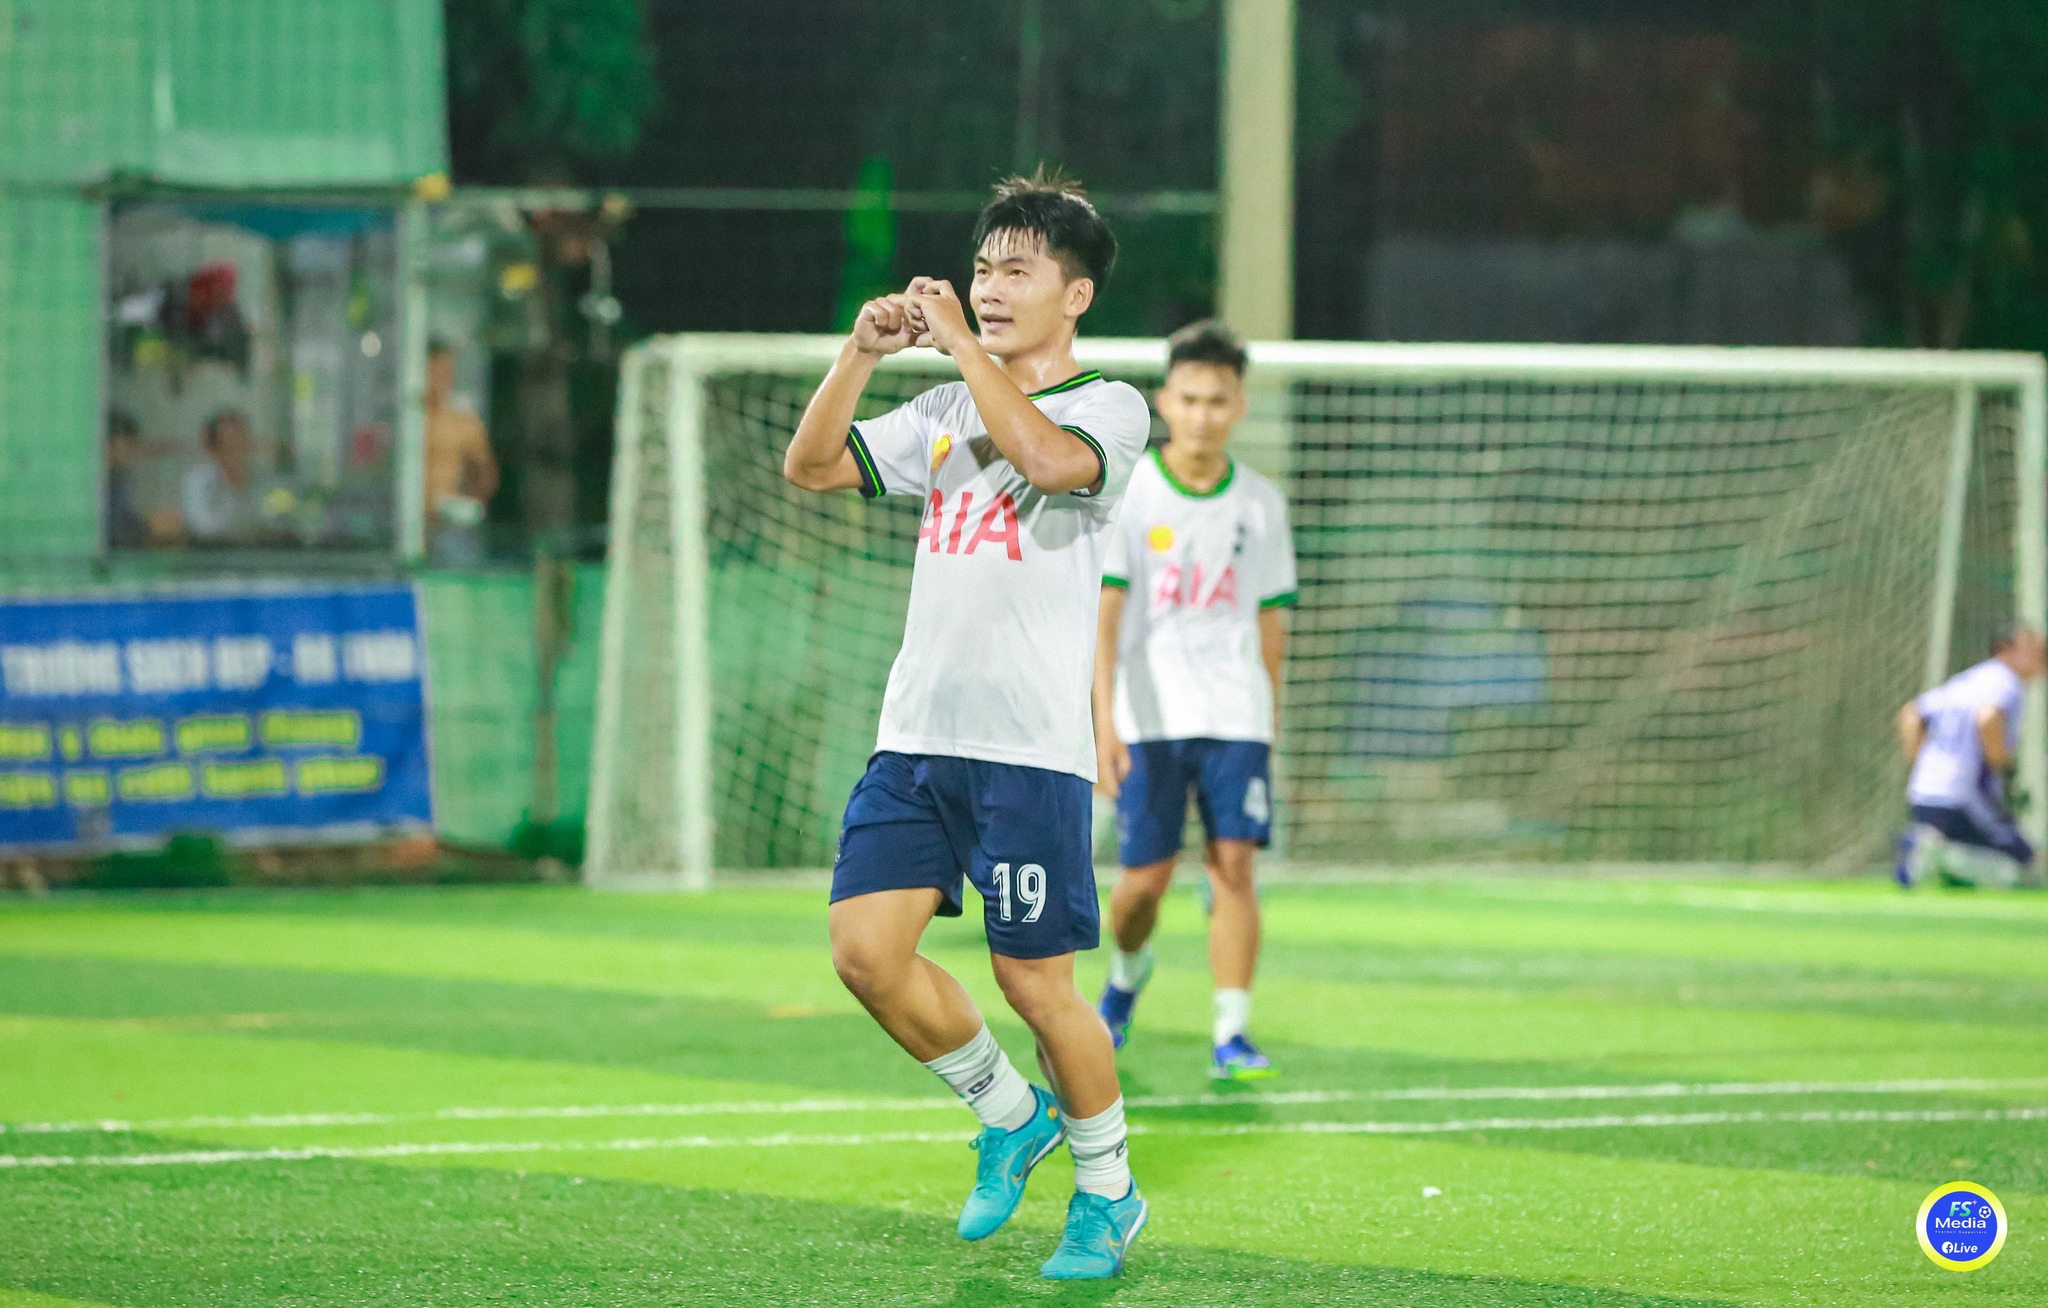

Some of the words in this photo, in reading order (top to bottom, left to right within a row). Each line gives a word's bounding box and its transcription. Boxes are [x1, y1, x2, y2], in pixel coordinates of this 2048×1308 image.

[918, 487, 1023, 561] AIA
[1155, 564, 1239, 609] AIA
[992, 862, 1047, 923] 19
